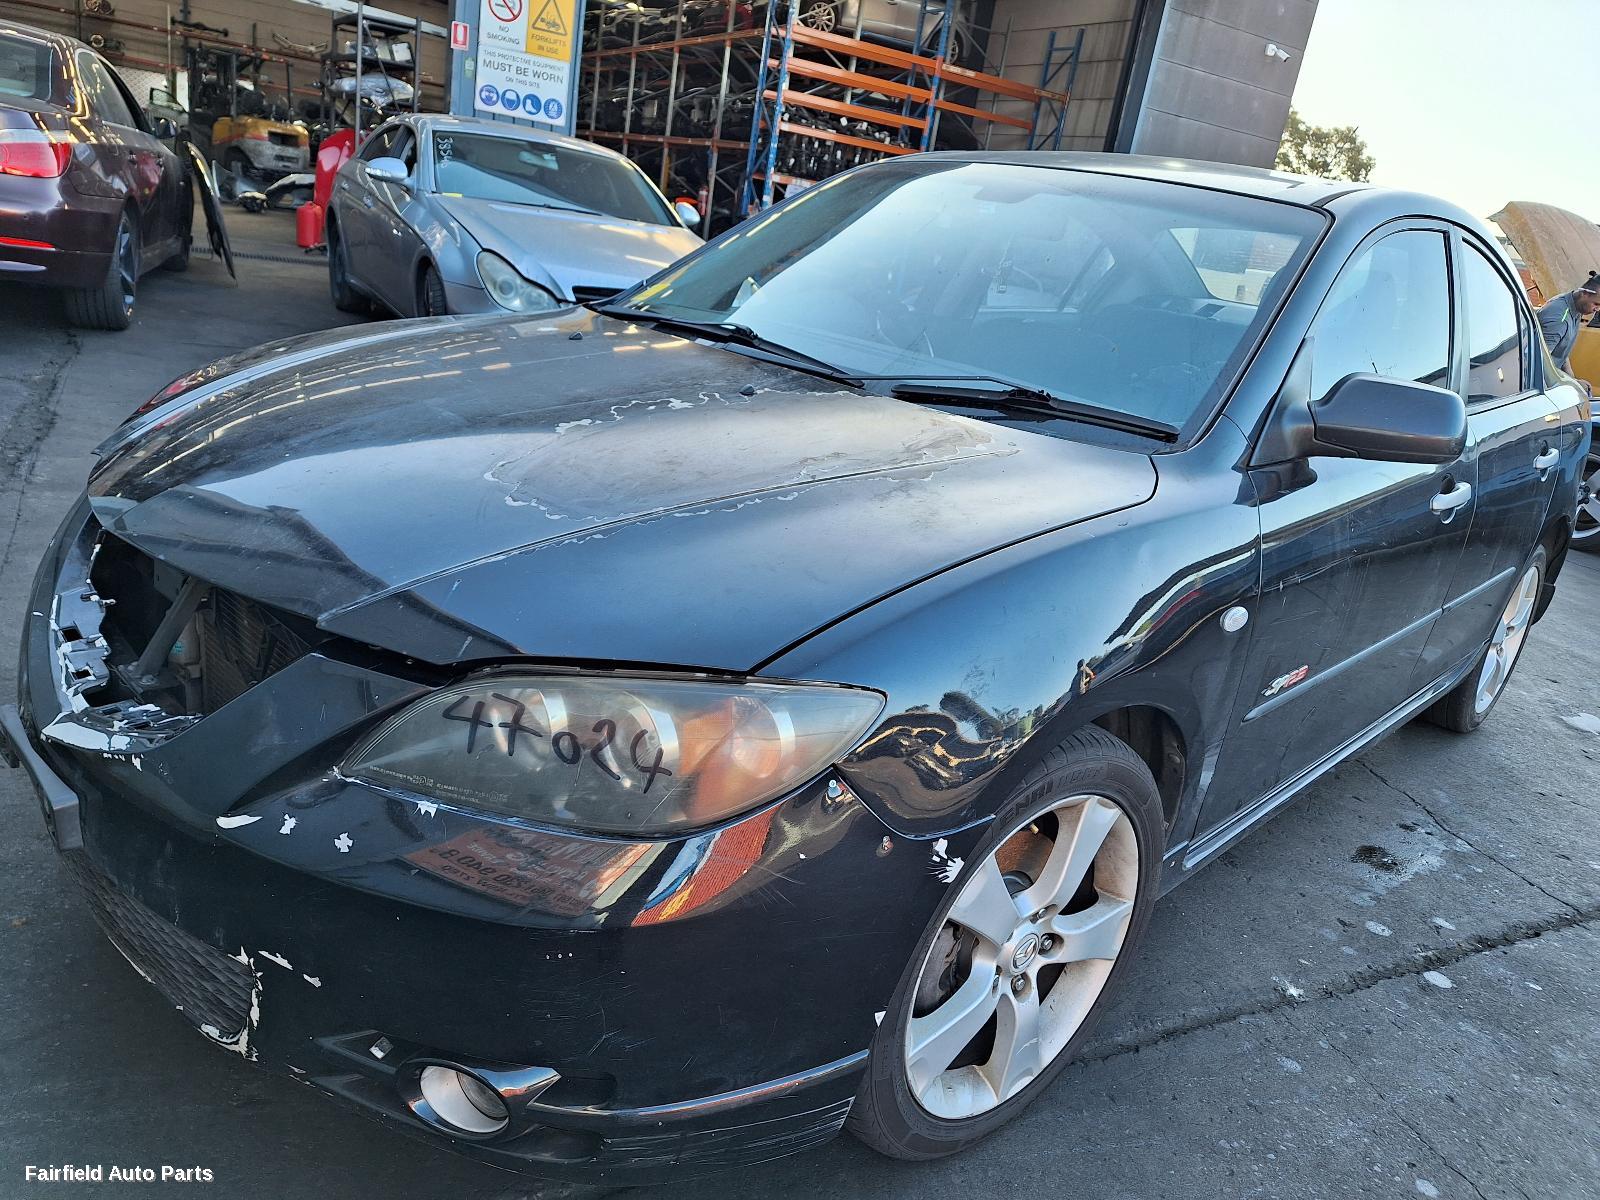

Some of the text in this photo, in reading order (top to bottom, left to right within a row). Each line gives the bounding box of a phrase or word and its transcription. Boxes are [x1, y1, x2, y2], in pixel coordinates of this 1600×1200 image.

[499, 25, 509, 33] NO
[487, 32, 520, 45] SMOKING
[531, 34, 566, 47] FORKLIFTS
[546, 46, 559, 54] USE
[484, 49, 564, 72] THIS PROTECTIVE EQUIPMENT
[483, 58, 512, 72] MUST
[515, 66, 529, 77] BE
[532, 69, 564, 84] WORN
[515, 78, 528, 86] THIS
[529, 80, 540, 88] SITE
[442, 692, 673, 794] 47024
